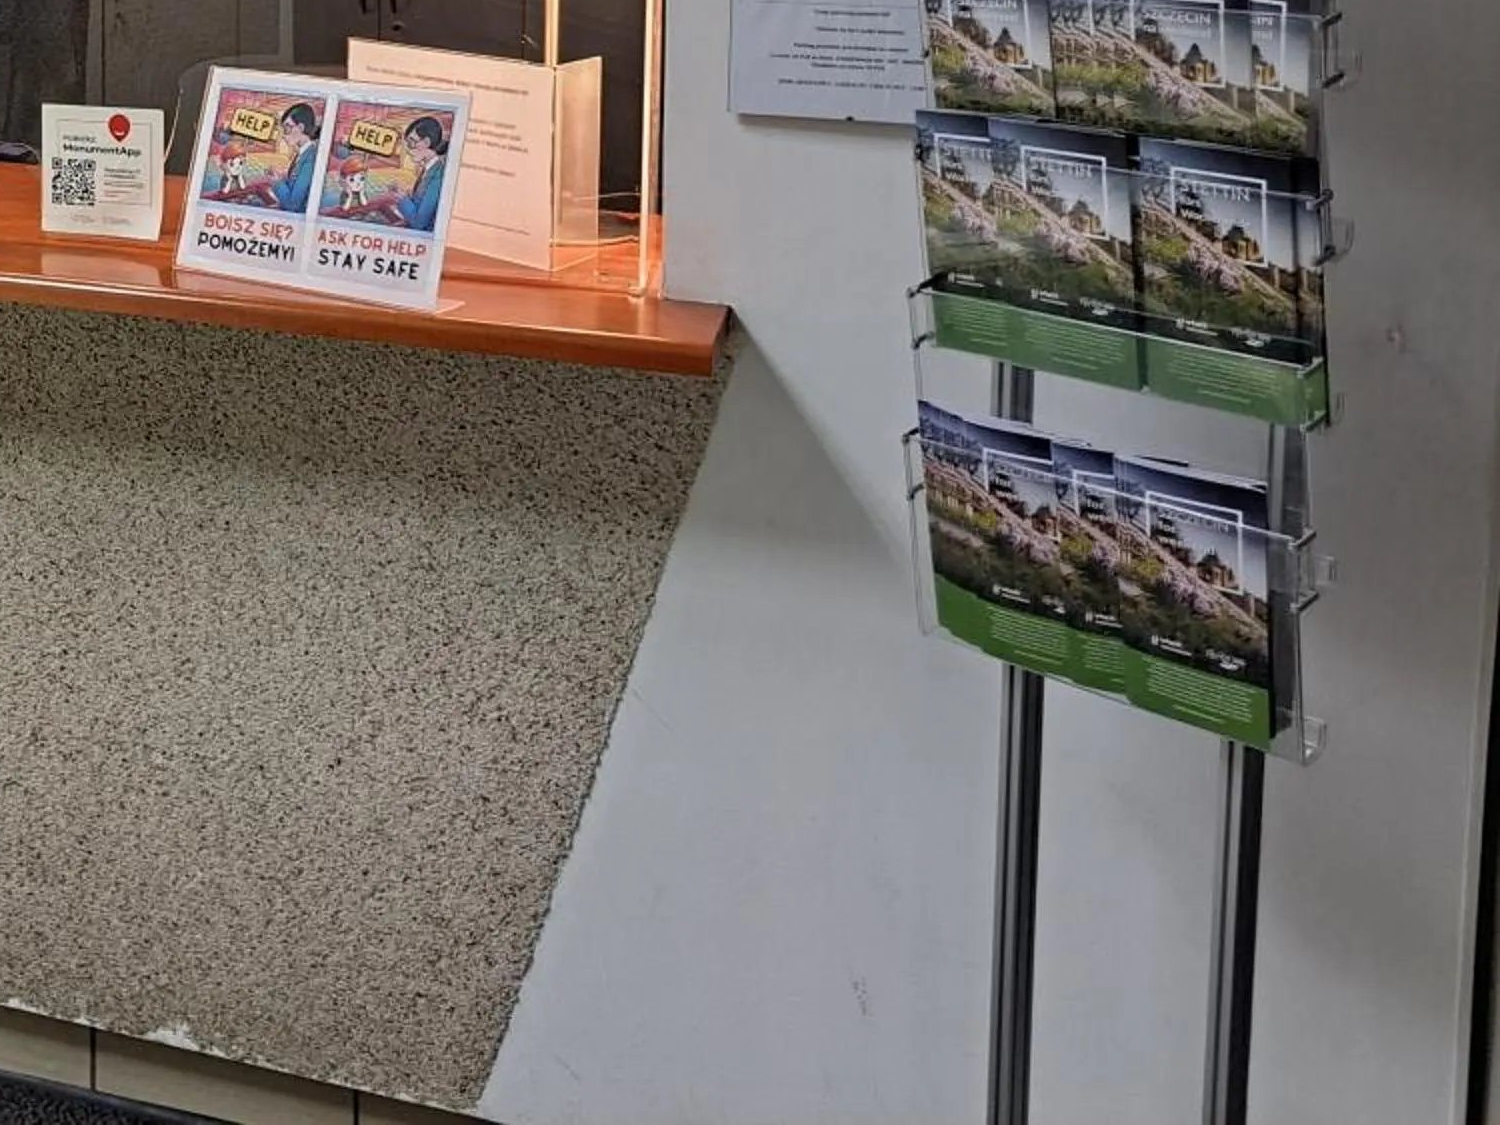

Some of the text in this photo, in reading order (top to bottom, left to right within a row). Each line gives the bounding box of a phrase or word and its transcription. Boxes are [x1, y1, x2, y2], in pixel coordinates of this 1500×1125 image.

[236, 114, 270, 133] HELP
[355, 126, 394, 148] HELP
[63, 143, 142, 158] MonumentApp
[204, 212, 295, 243] BOISZ SIĘ?
[196, 231, 296, 263] POMOŻEMY!
[317, 229, 427, 257] ASK FOR HELP
[317, 248, 421, 281] STAY SAFE
